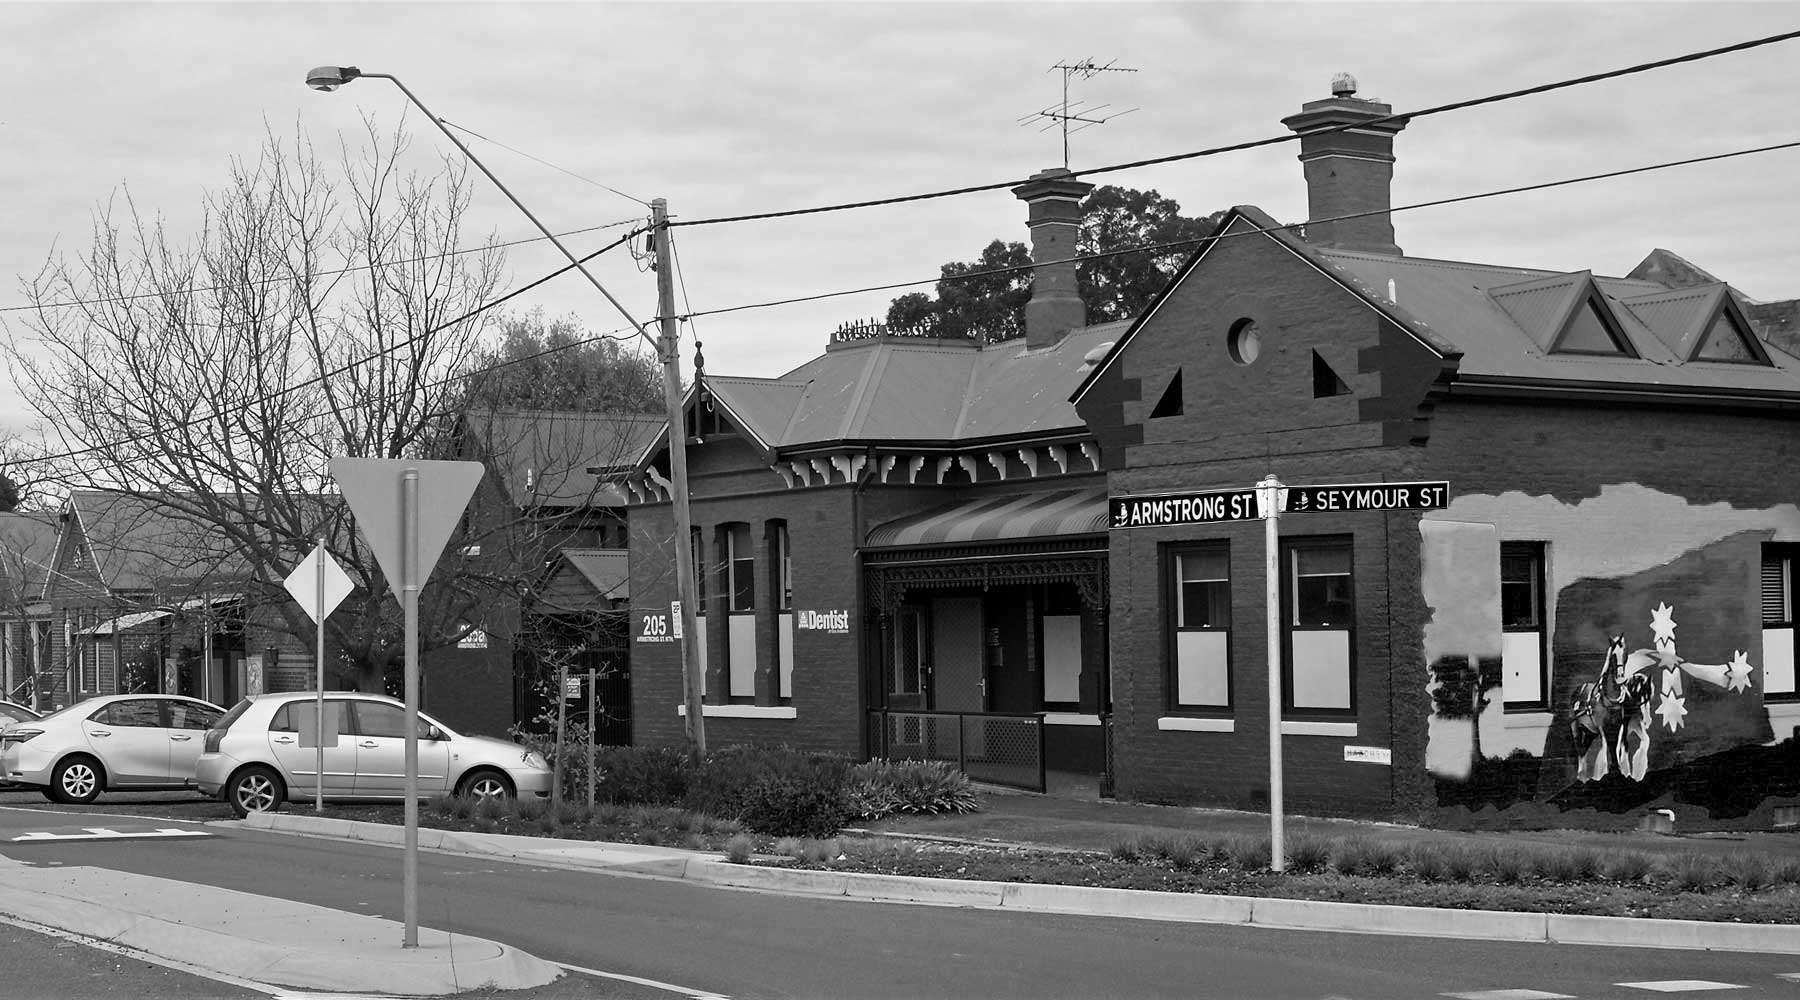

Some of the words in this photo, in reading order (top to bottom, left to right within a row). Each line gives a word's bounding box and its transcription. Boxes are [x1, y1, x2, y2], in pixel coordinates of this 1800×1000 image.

[1130, 495, 1225, 525] ARMSTRONG
[1230, 493, 1253, 519] ST
[1316, 488, 1409, 510] SEYMOUR
[1420, 487, 1444, 508] ST
[643, 616, 666, 635] 205
[809, 610, 848, 629] Dentist
